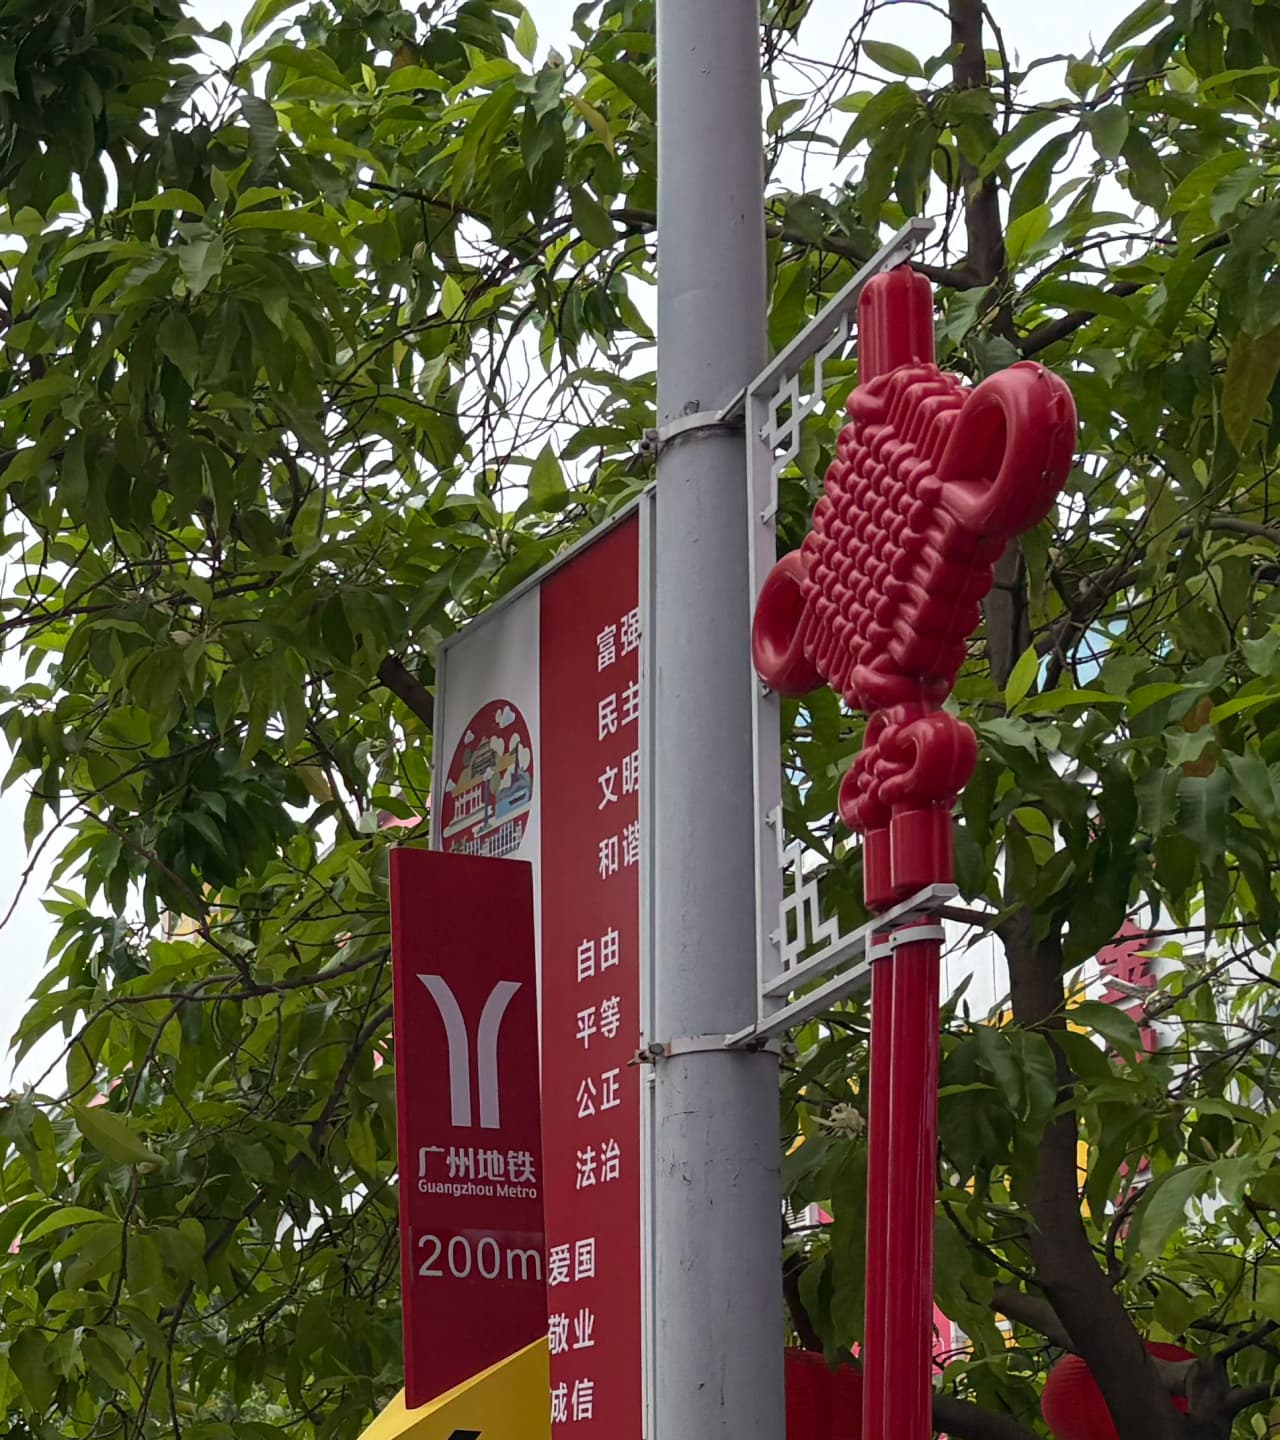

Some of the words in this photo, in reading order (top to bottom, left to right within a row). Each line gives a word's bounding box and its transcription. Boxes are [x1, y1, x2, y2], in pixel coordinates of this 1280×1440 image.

[576, 926, 620, 983] 自由
[575, 995, 621, 1050] 平等
[575, 1067, 621, 1120] 公正
[418, 1146, 536, 1183] 广州地铁
[575, 1139, 621, 1191] 法治
[418, 1180, 493, 1199] Guangzhou
[497, 1183, 537, 1199] Metro
[417, 1234, 542, 1281] 200m
[548, 1237, 596, 1286] 爱国
[547, 1308, 595, 1355] 敬业
